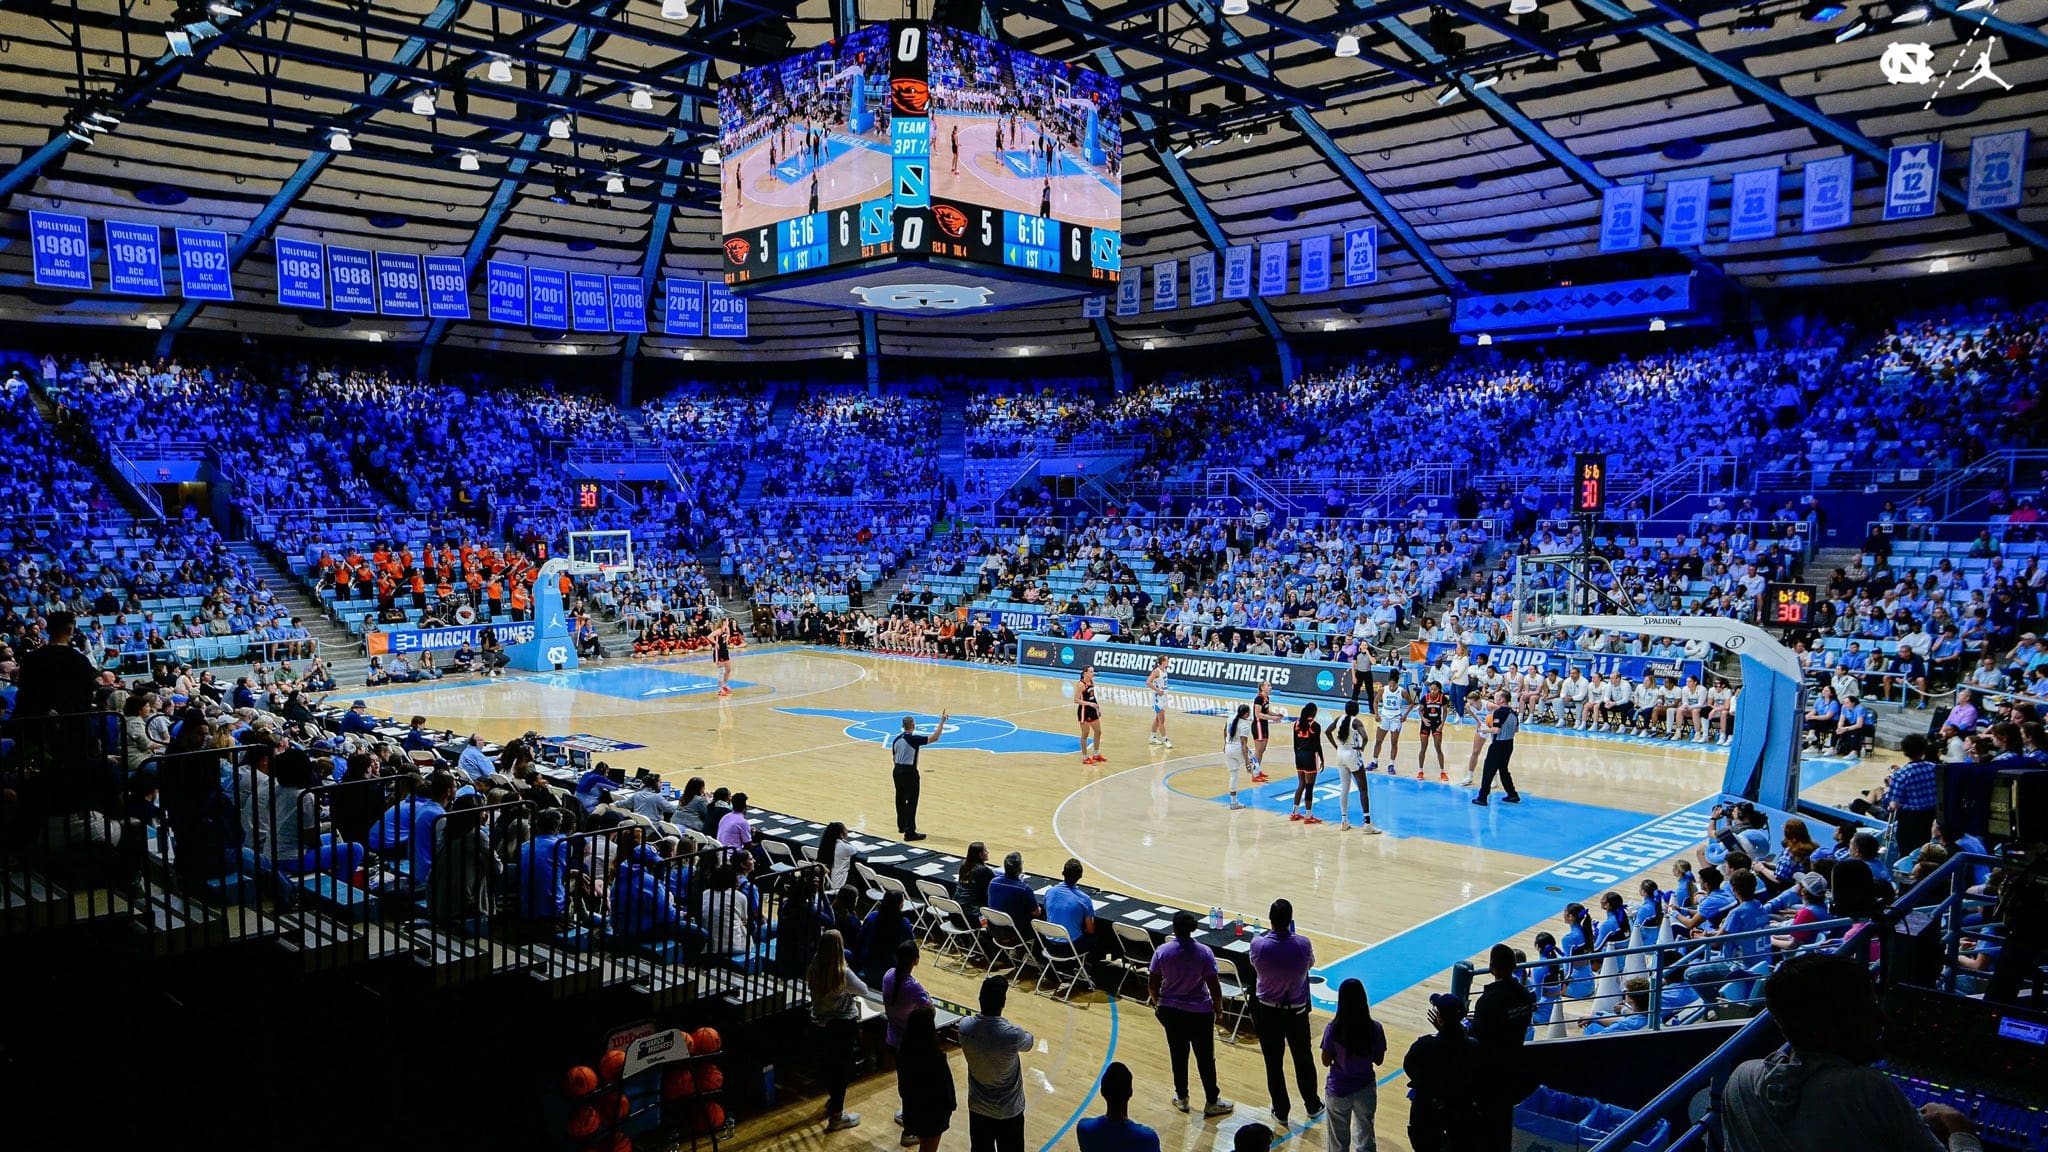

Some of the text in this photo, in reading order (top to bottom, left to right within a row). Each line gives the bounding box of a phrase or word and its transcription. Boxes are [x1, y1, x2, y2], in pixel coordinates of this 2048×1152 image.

[897, 27, 920, 62] 0
[897, 122, 926, 134] TEAM
[894, 139, 918, 154] 3PT
[1982, 162, 2010, 182] 20
[1902, 172, 1922, 191] 12
[37, 220, 82, 233] VOLLEYBALL
[790, 215, 814, 248] 6:16
[839, 210, 849, 247] 6
[900, 216, 924, 249] 0
[981, 210, 992, 246] 5
[1018, 214, 1045, 247] 6:16
[112, 230, 154, 242] VOLLEYBALL
[182, 237, 222, 248] VOLLEYBALL
[38, 235, 85, 257] 1980
[282, 246, 318, 258] VOLLEYBALL
[760, 228, 769, 263] 5
[1072, 227, 1081, 262] 6
[113, 244, 156, 265] 1981
[183, 250, 226, 270] 1982
[332, 254, 368, 264] VOLLEYBALL
[797, 250, 808, 270] 1ST
[1026, 250, 1038, 269] 1ST
[1354, 250, 1368, 265] 23
[54, 258, 70, 268] ACC
[281, 259, 320, 279] 1983
[382, 260, 415, 269] VOLLEYBALL
[428, 264, 461, 272] VOLLEYBALL
[40, 268, 86, 280] CHAMPIONS
[129, 266, 144, 276] ACC
[200, 273, 214, 281] ACC
[332, 266, 371, 285] 1988
[492, 268, 522, 280] VOLLEYBALL
[1230, 266, 1244, 280] 20
[1354, 274, 1369, 282] SMITH
[116, 276, 158, 286] CHAMPIONS
[187, 282, 228, 292] CHAMPIONS
[294, 281, 308, 289] ACC
[381, 272, 418, 290] 1989
[428, 275, 464, 292] 1999
[534, 275, 562, 284] VOLLEYBALL
[574, 280, 602, 288] VOLLEYBALL
[1159, 280, 1172, 293] 25
[283, 288, 320, 300] CHAMPIONS
[490, 280, 524, 300] 2000
[534, 286, 564, 304] 2001
[670, 286, 700, 295] VOLLEYBALL
[336, 296, 372, 305] CHAMPIONS
[384, 300, 419, 309] CHAMPIONS
[442, 294, 454, 302] ACC
[574, 291, 604, 306] 2005
[613, 293, 642, 308] 2008
[669, 296, 700, 312] 2014
[432, 302, 465, 310] CHAMPIONS
[711, 298, 744, 314] 2016
[580, 492, 596, 507] 30
[1582, 480, 1598, 508] 30
[1778, 604, 1800, 622] 30
[1001, 612, 1034, 631] FOUR
[1644, 617, 1682, 626] SPALDING
[422, 631, 470, 648] MARCH
[1093, 650, 1291, 686] CELEBRATE STUDENT-ATHLETES
[1487, 648, 1548, 674] FOUR
[1652, 662, 1674, 670] MARCH
[1552, 834, 1693, 884] HEELS
